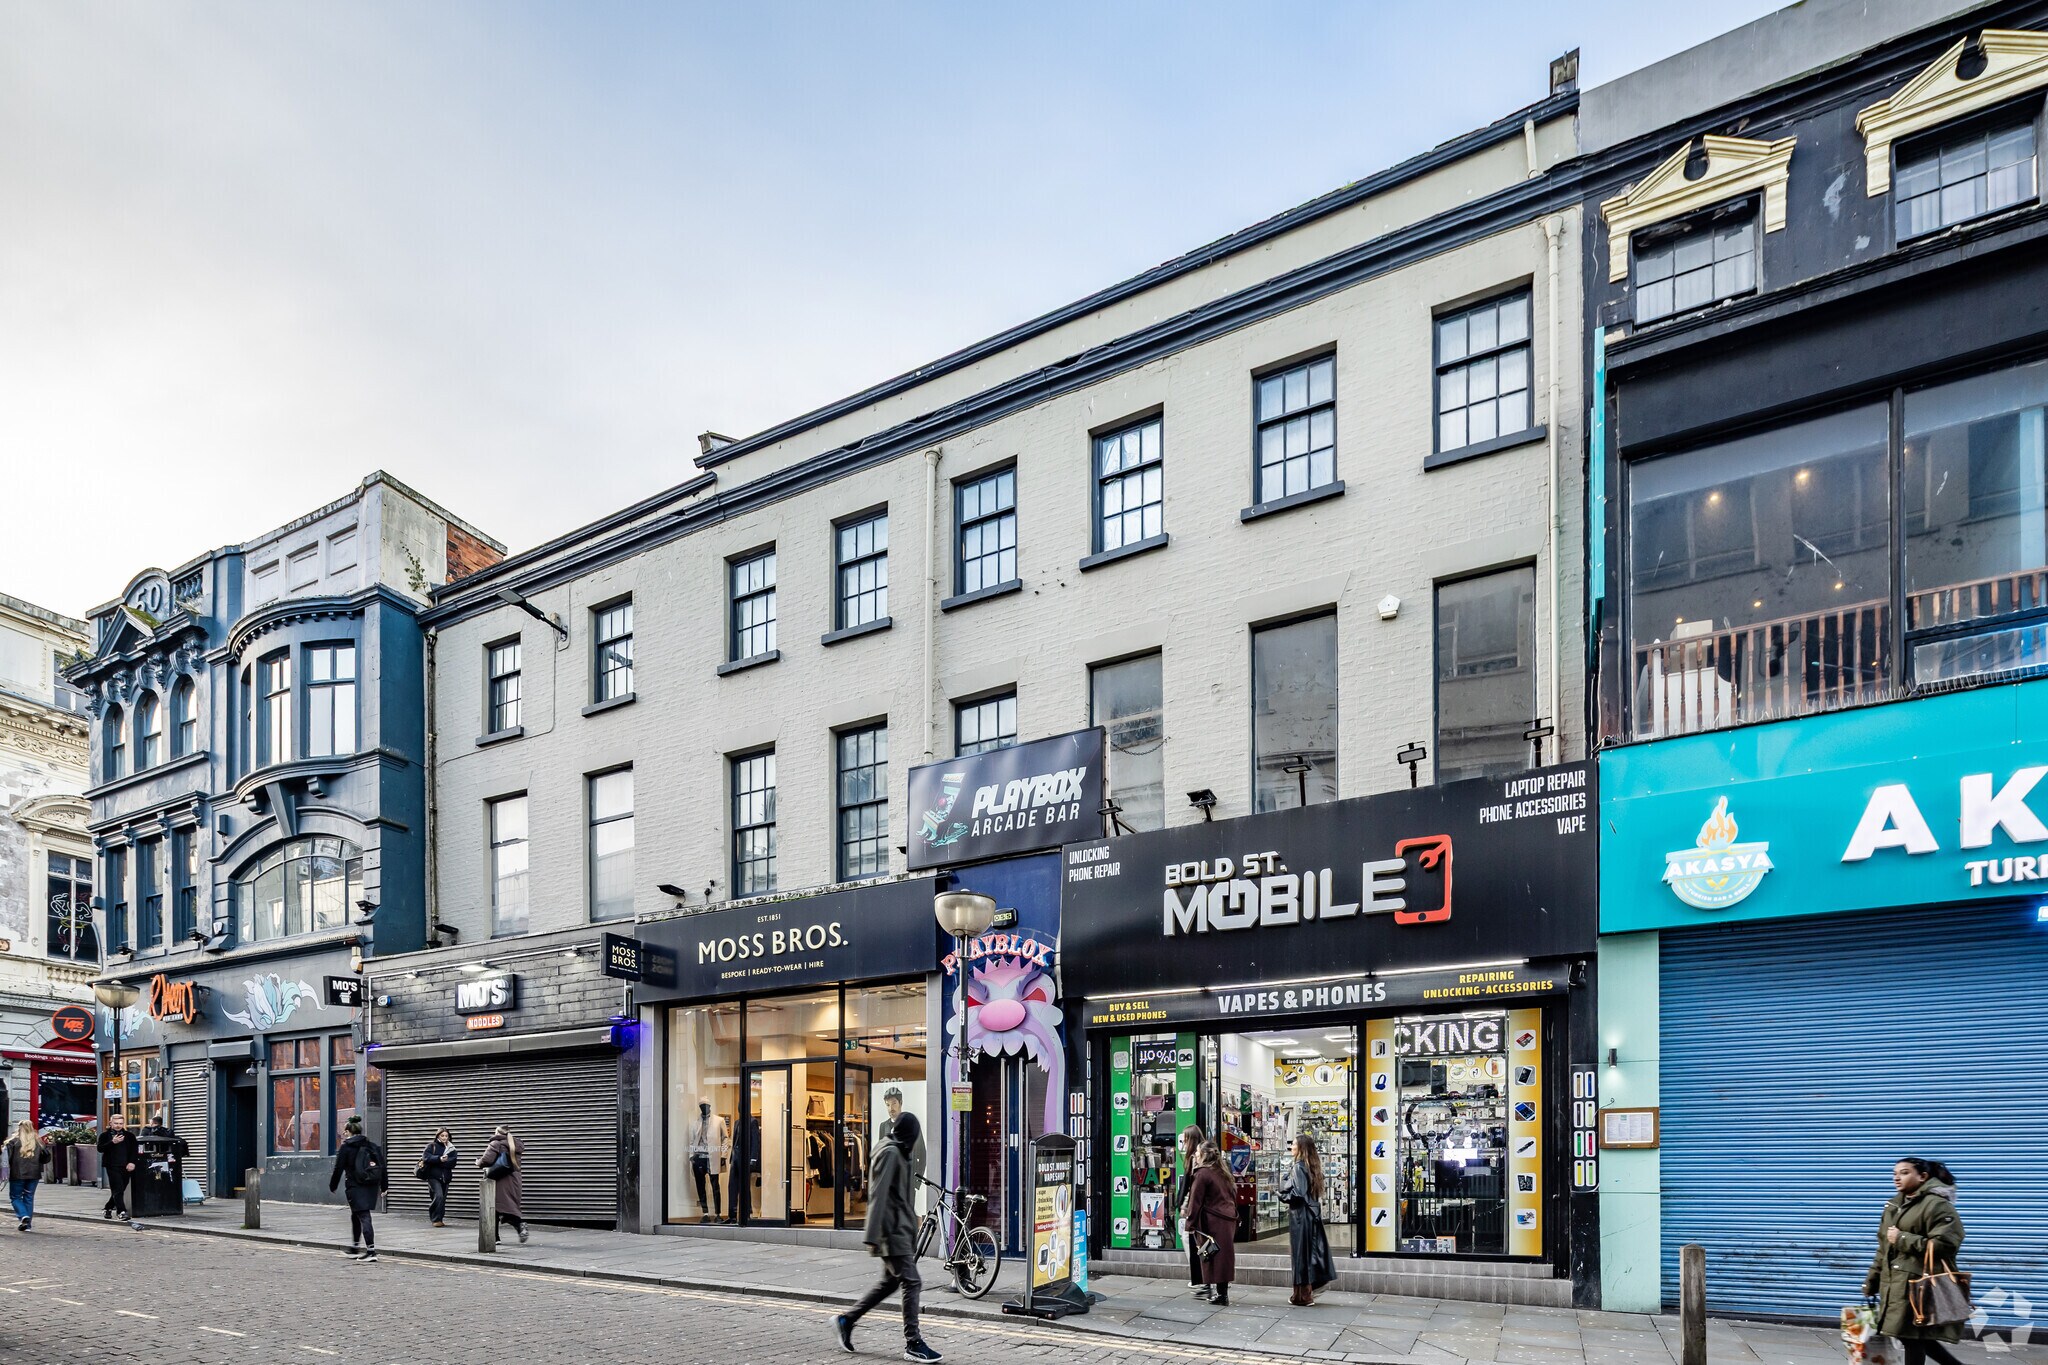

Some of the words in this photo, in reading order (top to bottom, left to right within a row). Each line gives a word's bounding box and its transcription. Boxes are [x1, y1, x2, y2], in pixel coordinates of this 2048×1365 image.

[971, 766, 1087, 819] PLAYBOX
[1505, 776, 1545, 798] LAPTOP
[1547, 769, 1586, 791] REPAIR
[1479, 803, 1513, 824] PHONE
[1515, 792, 1586, 819] ACCESSORIES
[971, 809, 1038, 837] ARCADE
[1045, 802, 1080, 825] BAR
[1557, 814, 1586, 835] VAPE
[1069, 845, 1109, 865] UNLOCKING
[1666, 852, 1770, 878] AKASYA
[1069, 866, 1093, 882] PHONE
[1094, 861, 1120, 879] REPAIR
[1164, 857, 1235, 887] BOLD
[1242, 850, 1288, 876] ST.
[1163, 857, 1407, 936] MOBILE
[1687, 887, 1712, 902] TURKISH
[612, 945, 636, 958] MOSS
[698, 932, 765, 964] MOSS
[772, 921, 849, 955] BROS.
[612, 954, 638, 969] BROS.
[721, 969, 746, 979] BESPOKE
[752, 963, 802, 975] READY-TO-WEAR
[808, 960, 824, 969] HIRE
[332, 980, 358, 991] MO'S
[1459, 970, 1515, 984] REPAIRING
[457, 978, 507, 1009] MO'S
[1217, 991, 1279, 1014] VAPES
[1283, 990, 1299, 1009] &
[1302, 982, 1387, 1007] PHONES
[1423, 980, 1553, 999] UNLOCKING-ACCESSORIES
[1092, 1014, 1109, 1024] NEW
[1110, 1014, 1116, 1023] &
[1116, 1013, 1136, 1022] USED
[1136, 1010, 1167, 1021] PHONES
[1109, 1002, 1125, 1012] BUY
[1126, 1002, 1132, 1010] &
[1132, 1001, 1150, 1010] SELL
[468, 1016, 501, 1028] NOODLES
[1394, 1021, 1499, 1054] CKING
[24, 1053, 49, 1061] Bookings
